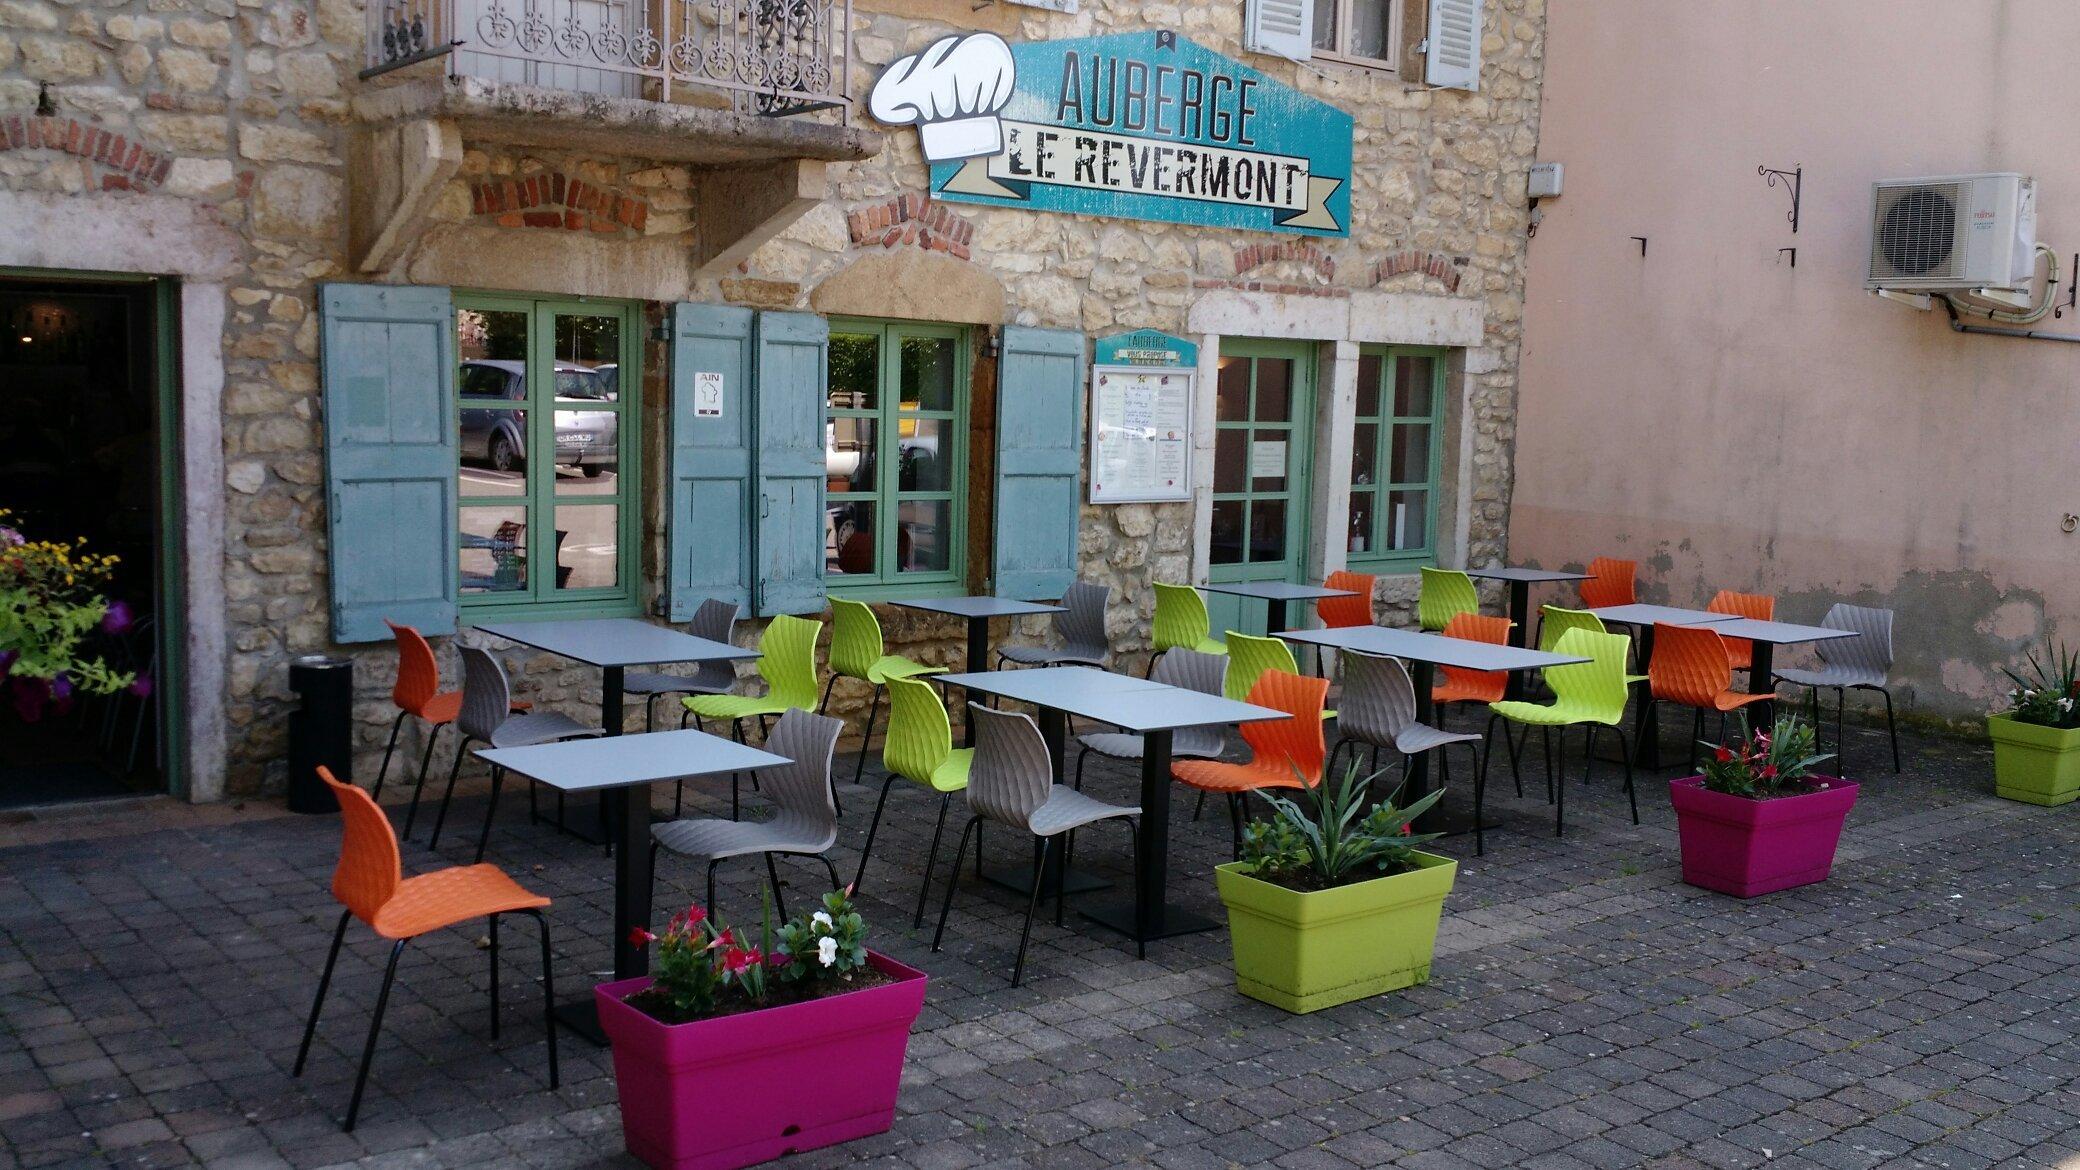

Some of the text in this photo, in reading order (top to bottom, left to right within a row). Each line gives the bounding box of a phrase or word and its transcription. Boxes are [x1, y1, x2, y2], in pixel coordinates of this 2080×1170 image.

[1056, 51, 1258, 147] AUBERGE
[1008, 128, 1310, 205] LE REVERMONT
[700, 373, 720, 382] AIN
